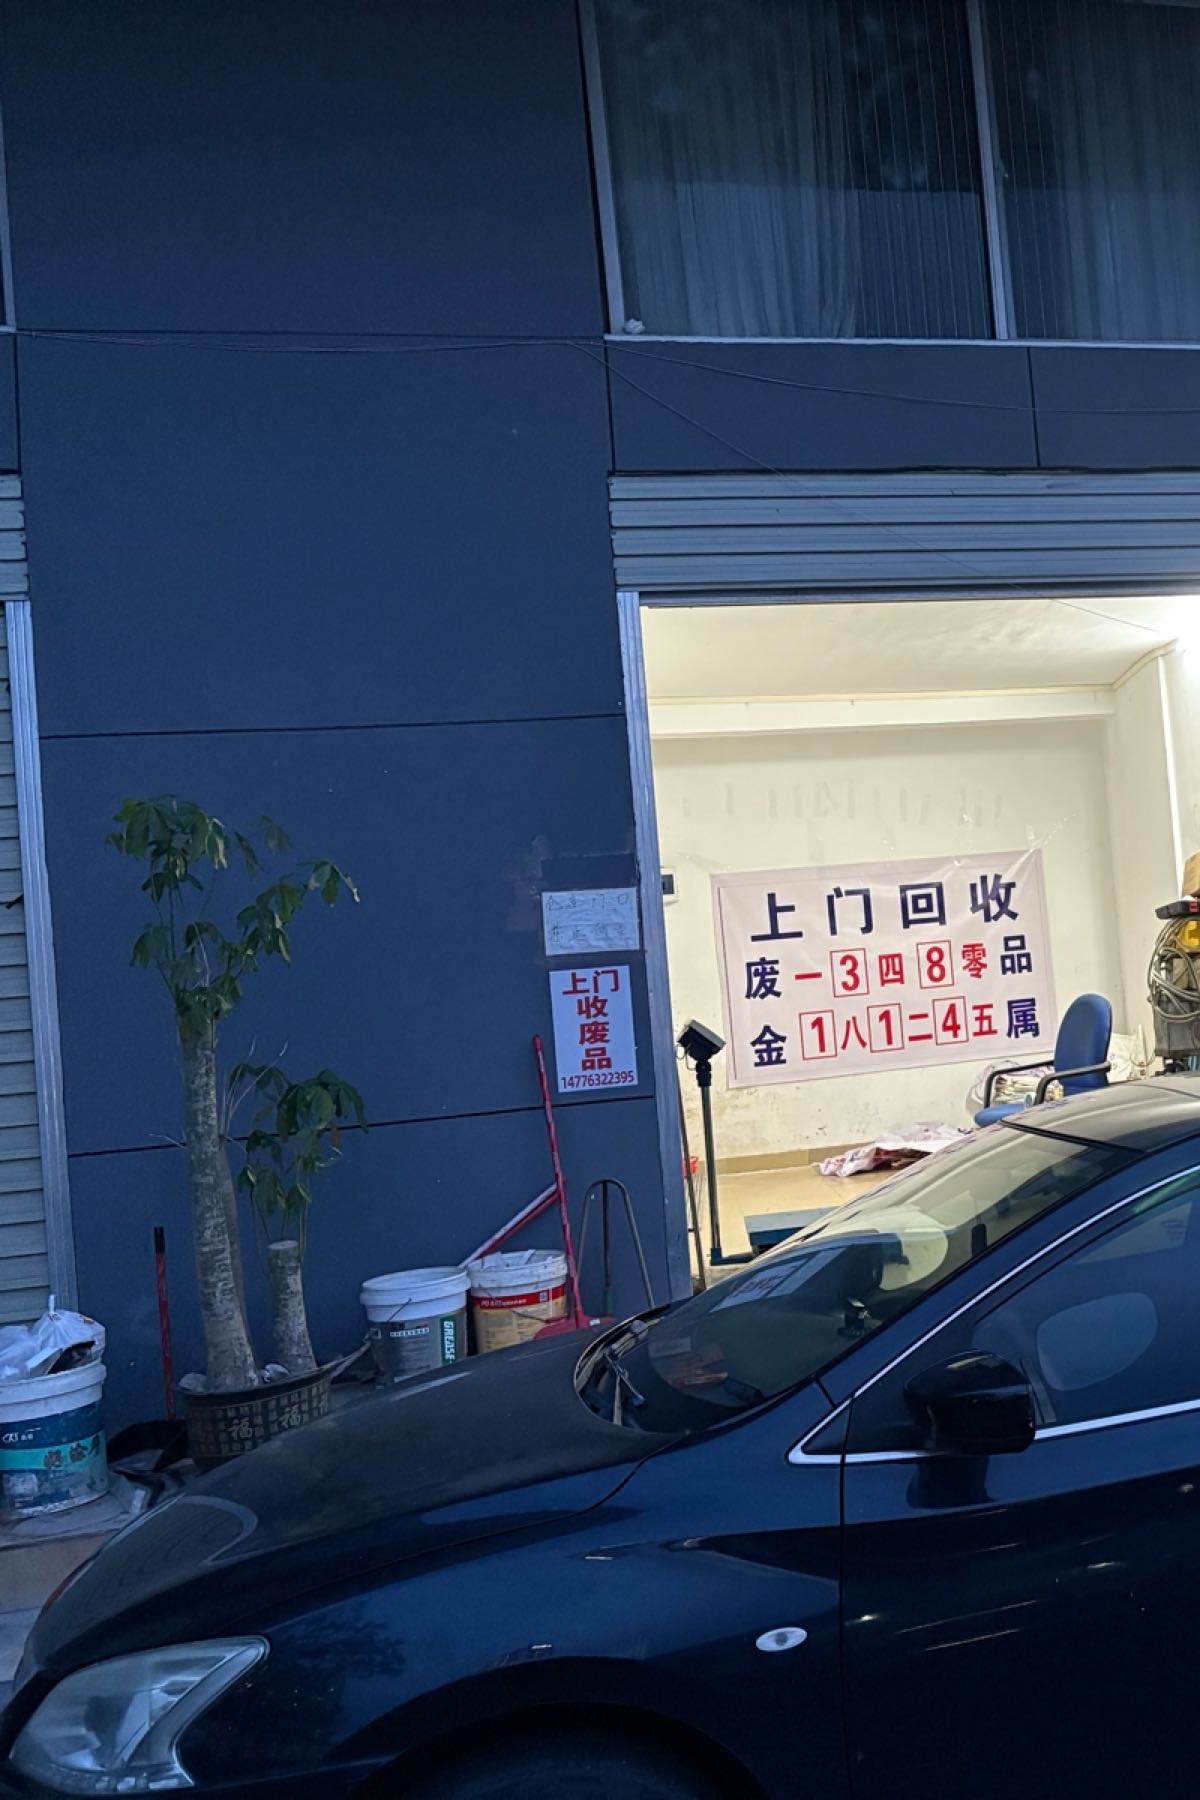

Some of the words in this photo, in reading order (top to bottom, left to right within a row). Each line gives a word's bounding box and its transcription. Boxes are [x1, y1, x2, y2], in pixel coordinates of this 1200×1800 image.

[750, 873, 1019, 942] 上门回收
[562, 969, 620, 995] 上门
[577, 996, 612, 1072] 收废品
[561, 1071, 635, 1089] 14776322395
[228, 1416, 253, 1440] 福
[279, 1404, 301, 1428] 福
